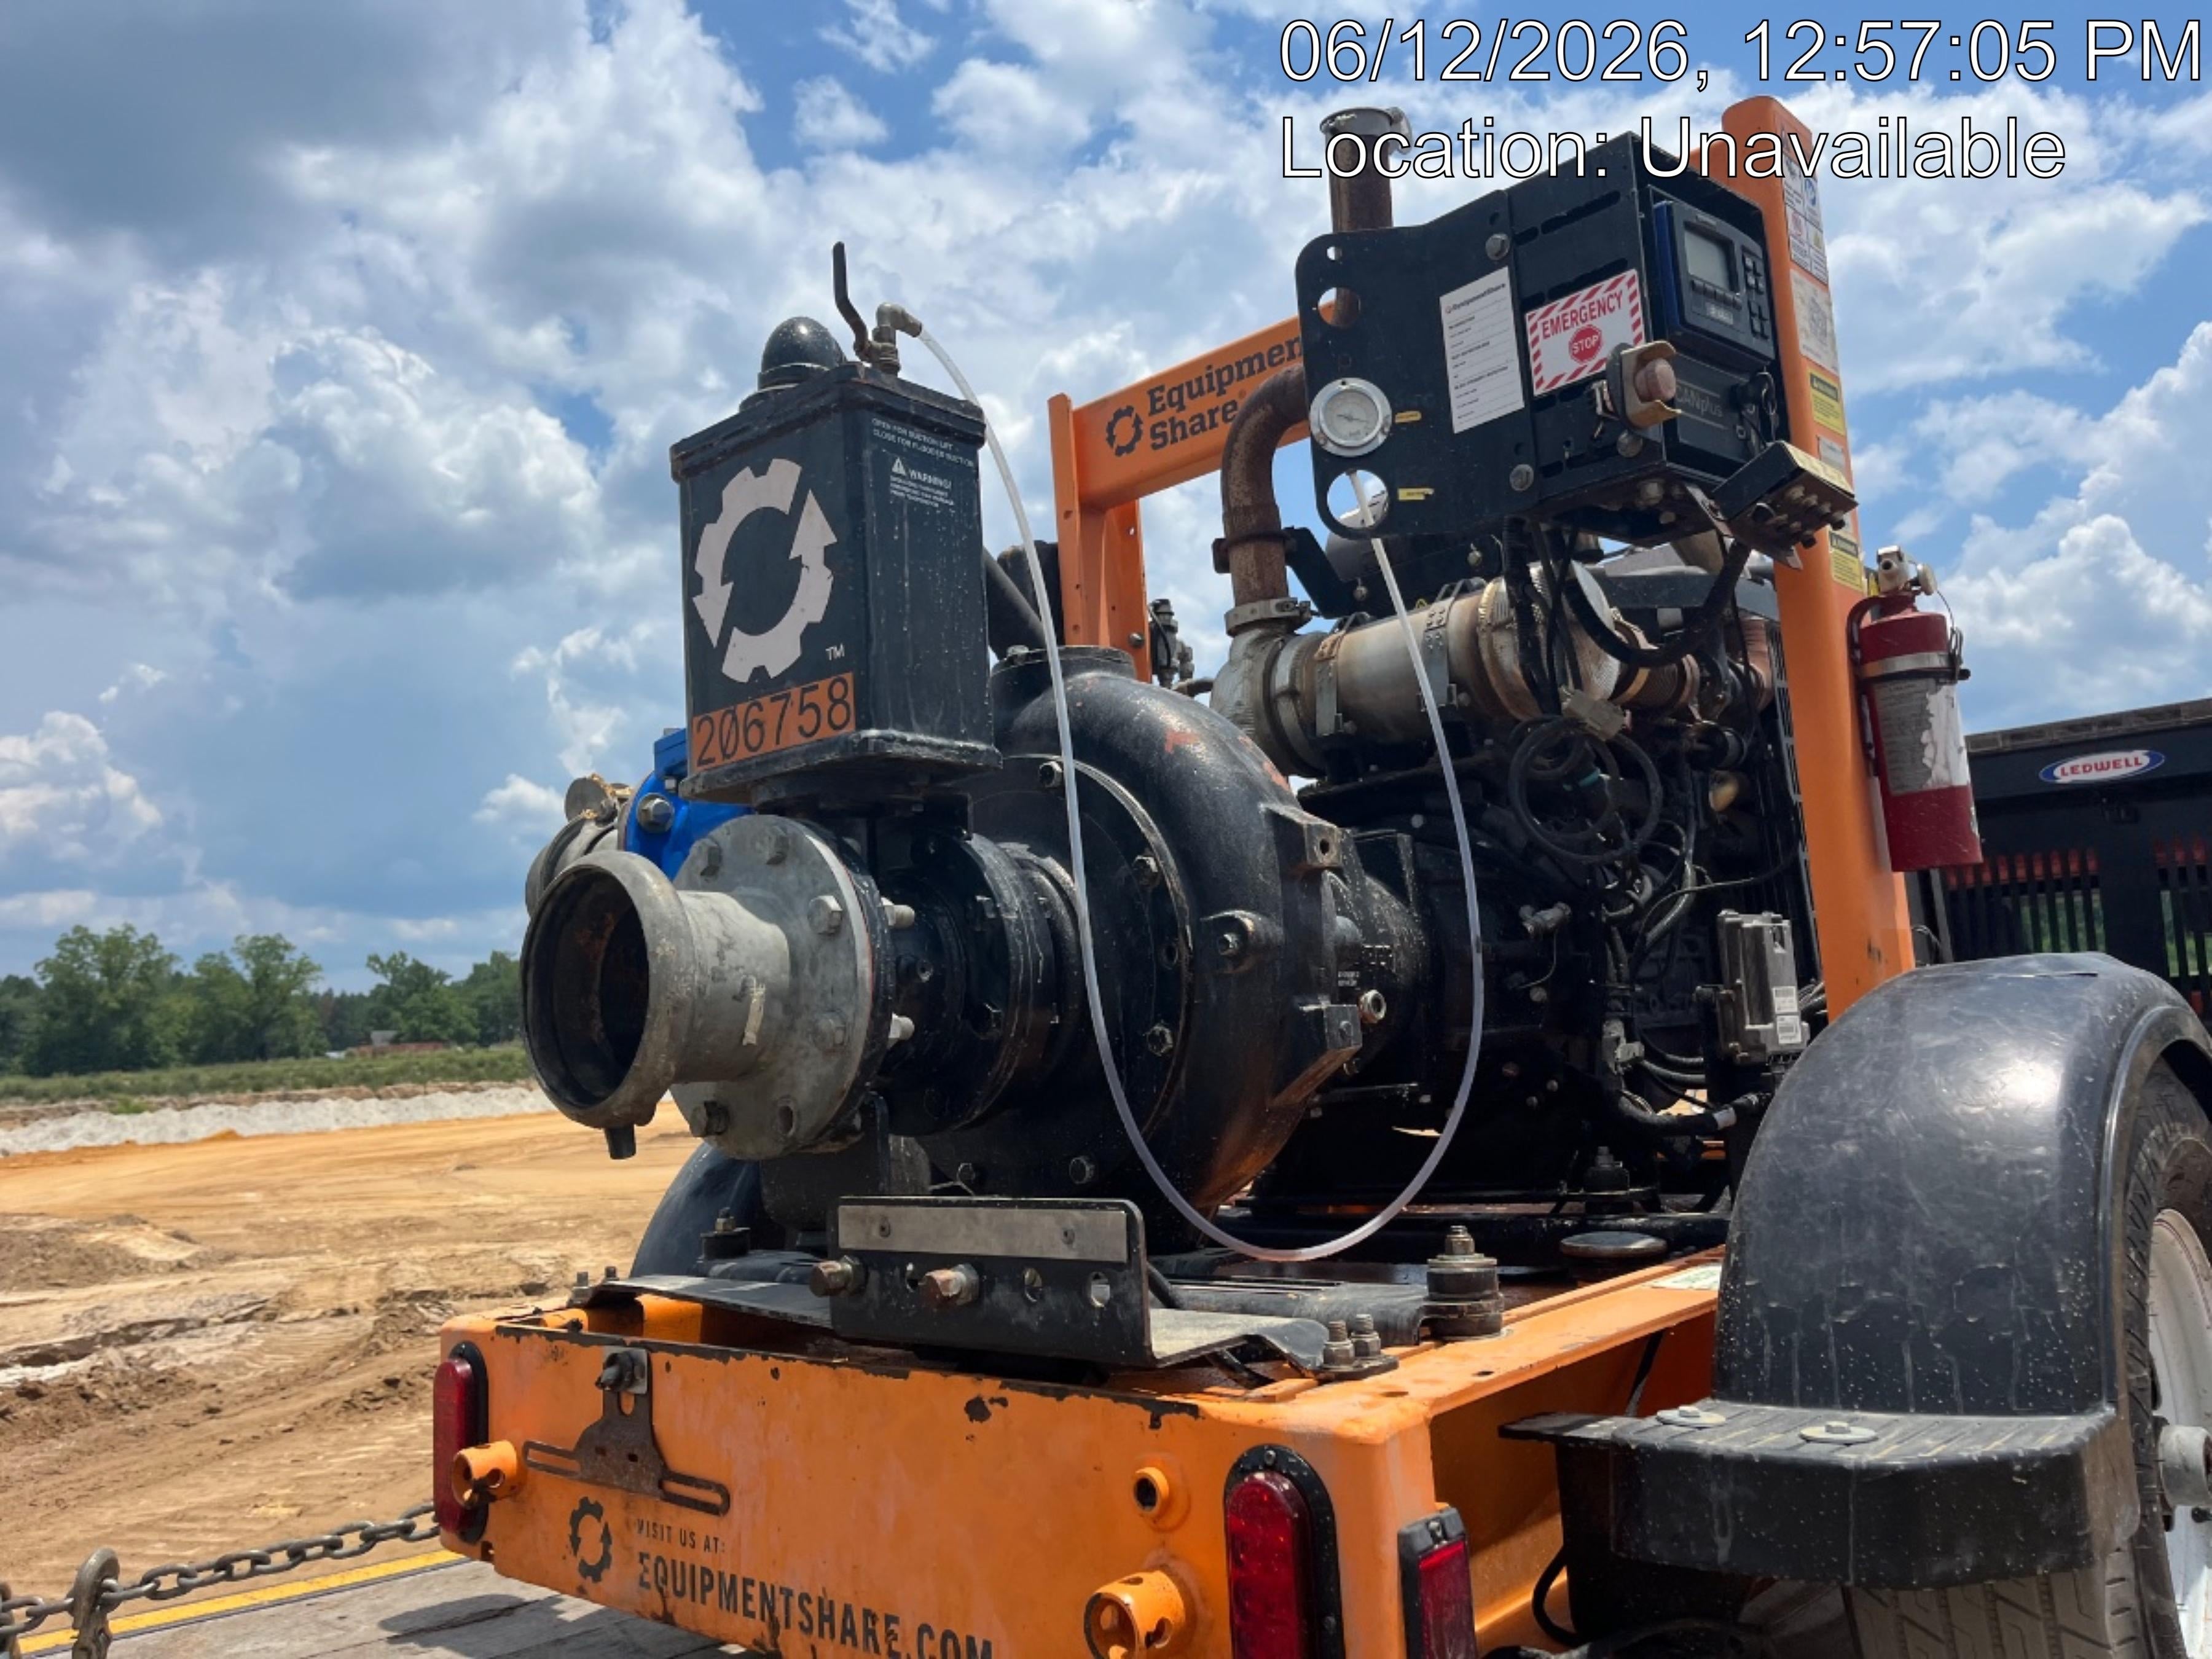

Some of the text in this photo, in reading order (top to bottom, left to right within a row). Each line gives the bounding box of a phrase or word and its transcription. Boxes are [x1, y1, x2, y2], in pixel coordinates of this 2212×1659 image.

[1542, 290, 1623, 339] EMERGENCY
[1572, 335, 1599, 353] STOP
[1147, 335, 1302, 417] Equipmen
[1150, 399, 1237, 450] Share
[696, 676, 852, 767] 206758
[2060, 756, 2143, 777] LEDWELL
[637, 1518, 726, 1554] VISIT US AT:
